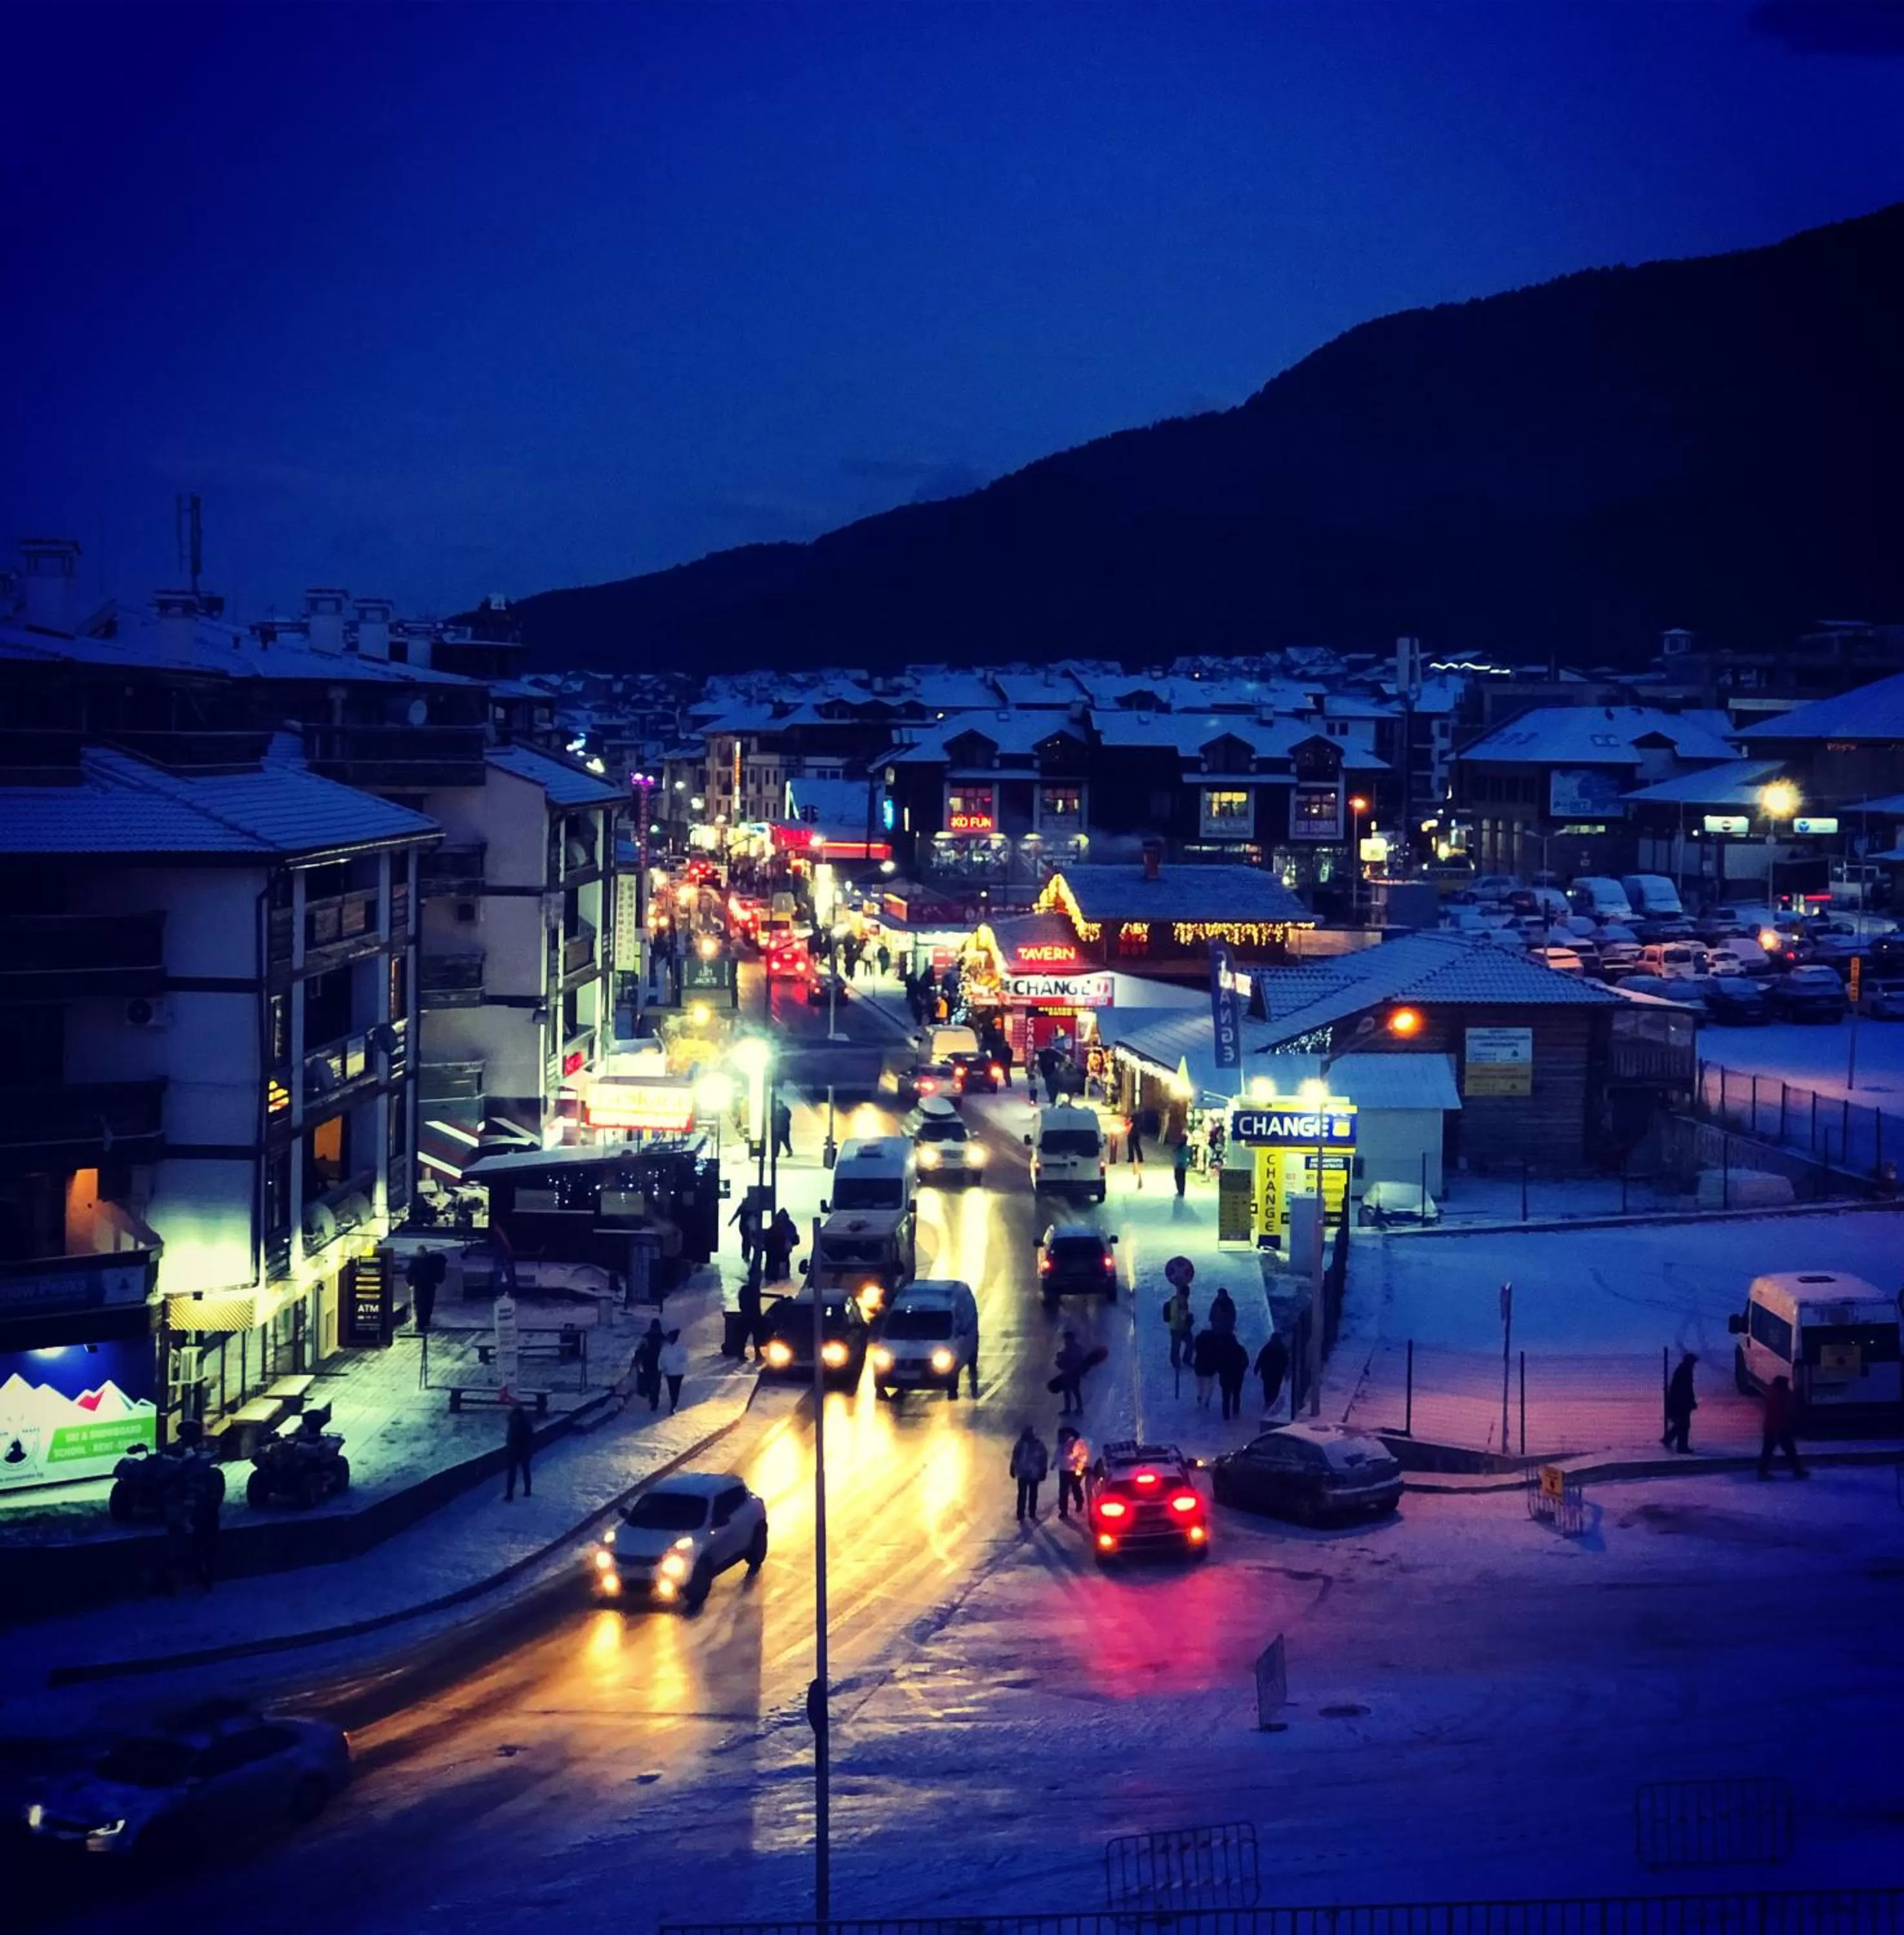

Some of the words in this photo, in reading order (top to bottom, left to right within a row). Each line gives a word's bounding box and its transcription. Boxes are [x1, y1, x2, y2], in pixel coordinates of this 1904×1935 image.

[970, 817, 991, 828] FUN
[1018, 946, 1075, 960] TAVERN
[1239, 1116, 1329, 1138] CHANGE
[1265, 1154, 1276, 1231] CHANGE
[357, 1304, 379, 1313] ATM
